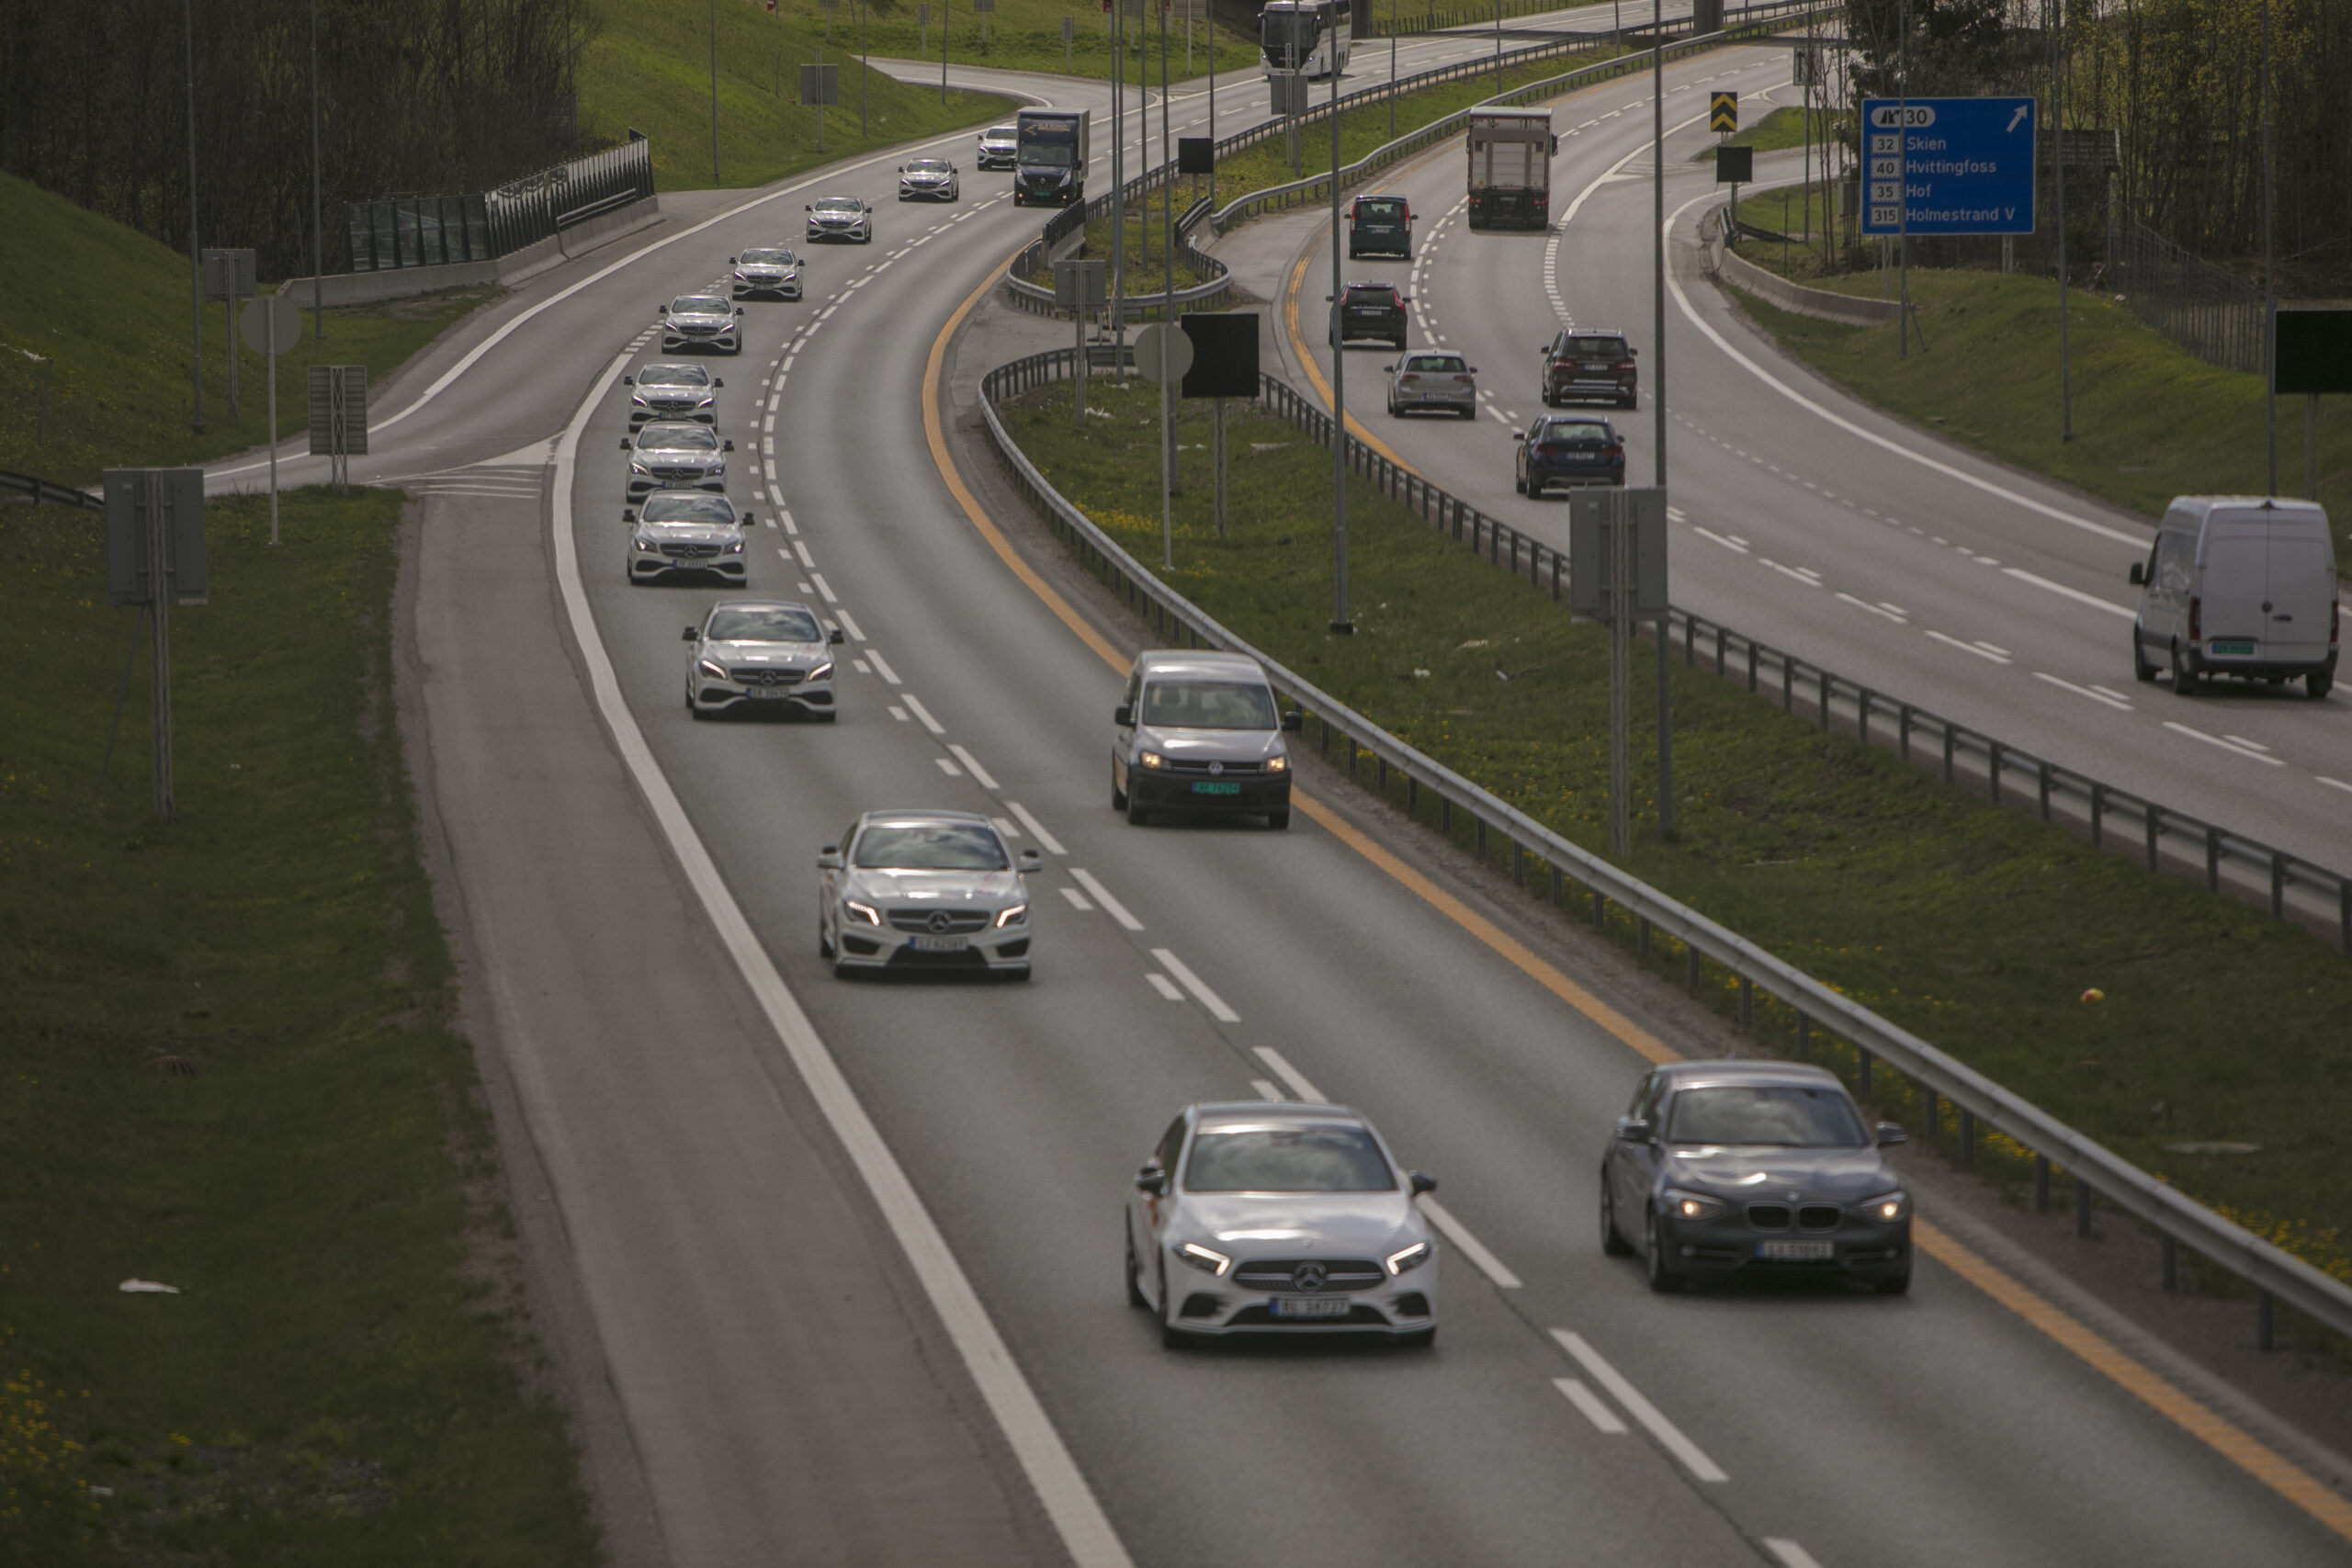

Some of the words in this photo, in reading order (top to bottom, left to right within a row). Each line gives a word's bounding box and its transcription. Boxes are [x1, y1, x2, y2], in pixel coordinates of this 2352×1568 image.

[1906, 109, 1928, 124] 30
[1877, 139, 1894, 151] 32
[1906, 137, 1946, 151] Skien
[1876, 163, 1894, 175] 40
[1905, 159, 1996, 176] Hvittingfoss
[1877, 186, 1894, 197] 35
[1905, 184, 1931, 197] Hof
[1874, 209, 1896, 221] 315
[1905, 208, 1999, 221] Holmestrand
[2004, 208, 2015, 220] V
